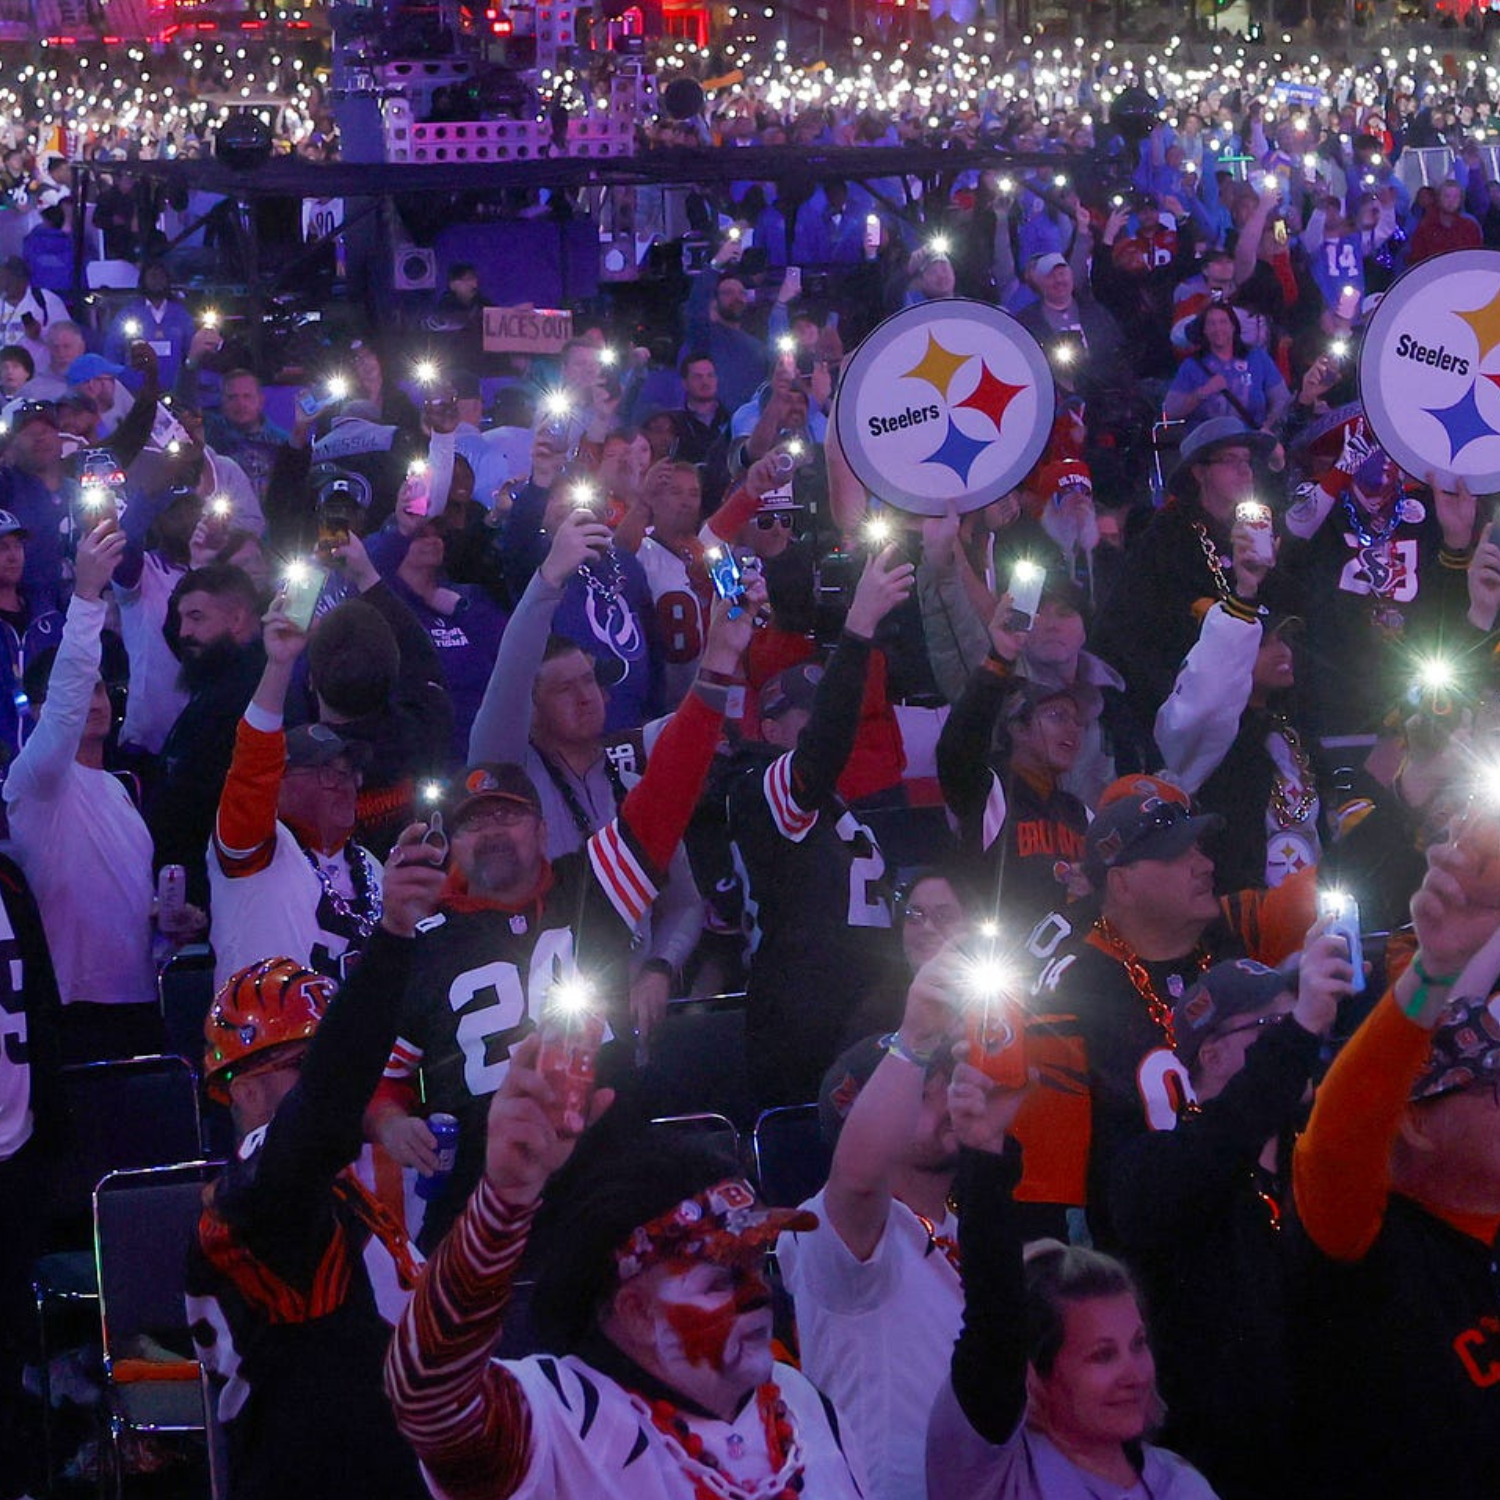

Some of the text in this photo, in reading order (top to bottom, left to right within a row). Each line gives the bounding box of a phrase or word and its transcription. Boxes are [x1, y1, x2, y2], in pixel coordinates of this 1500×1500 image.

[1323, 236, 1359, 277] 14
[485, 314, 572, 340] LACES OUT
[1396, 334, 1470, 376] Steelers
[868, 404, 941, 437] Steelers
